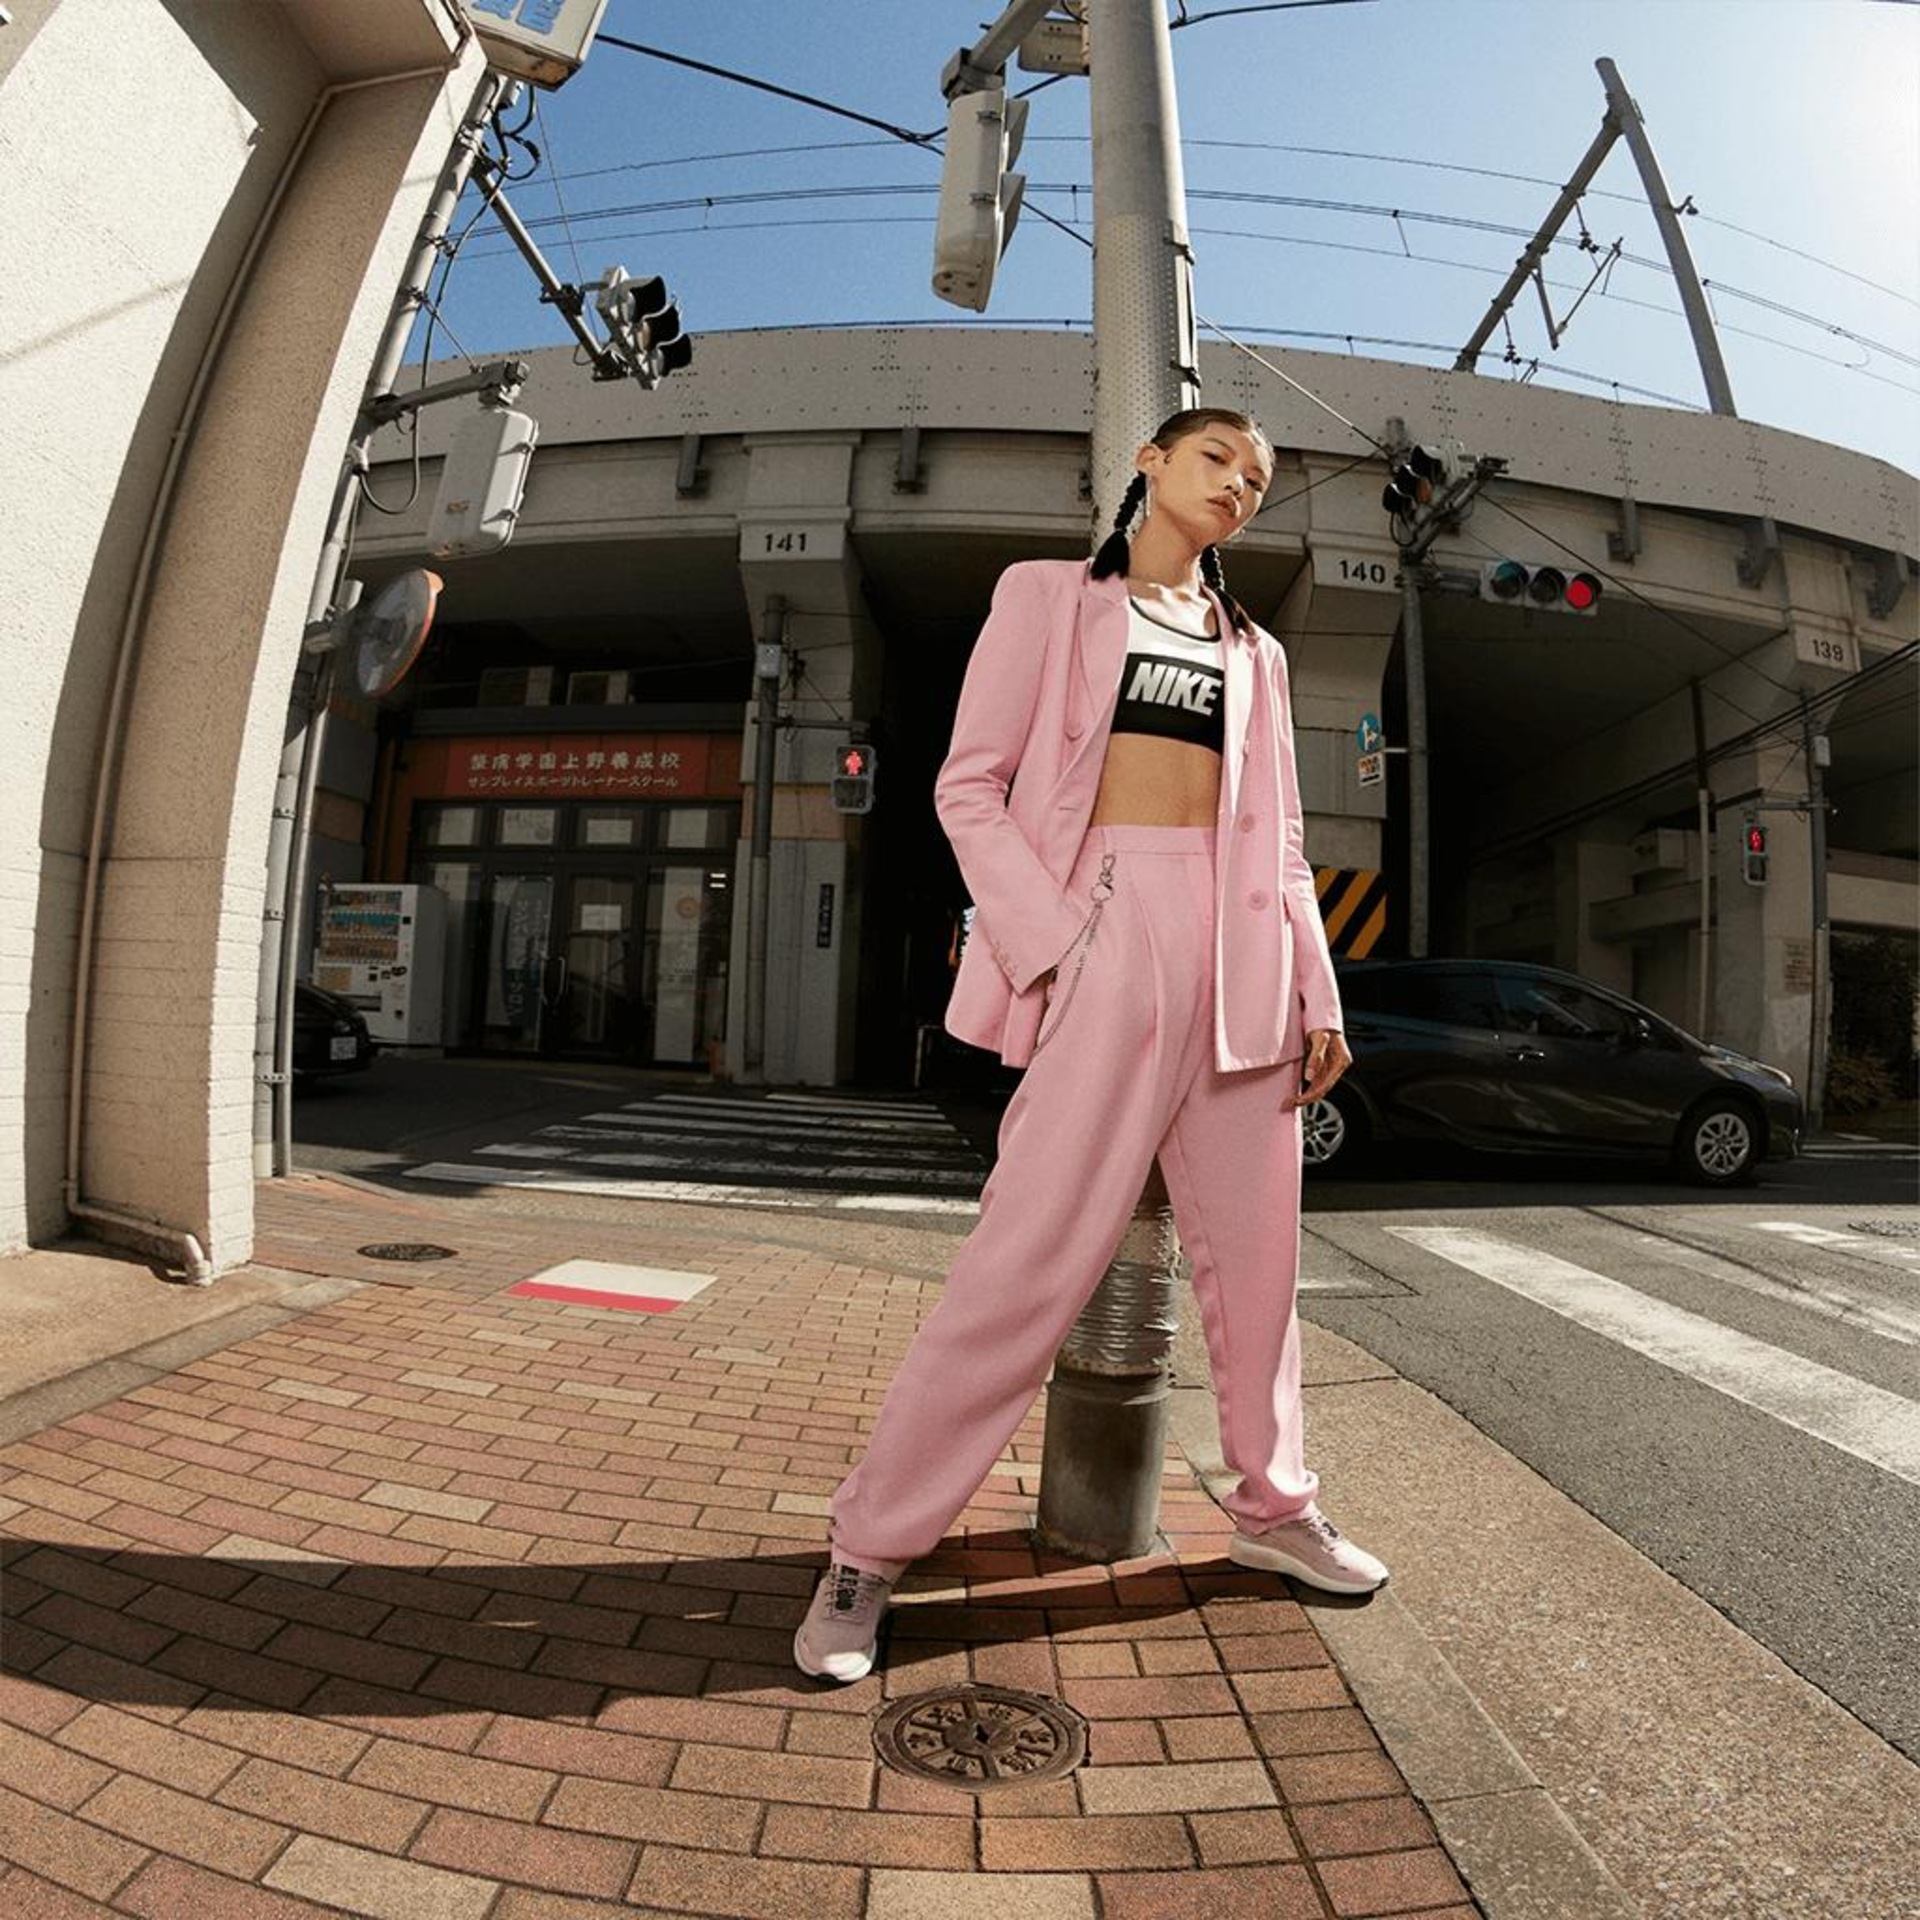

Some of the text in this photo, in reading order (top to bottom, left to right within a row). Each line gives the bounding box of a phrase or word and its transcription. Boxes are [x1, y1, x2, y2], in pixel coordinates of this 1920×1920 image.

[764, 532, 807, 552] 141
[1339, 560, 1386, 584] 140
[1812, 639, 1844, 662] 139
[1126, 662, 1223, 716] NIKE
